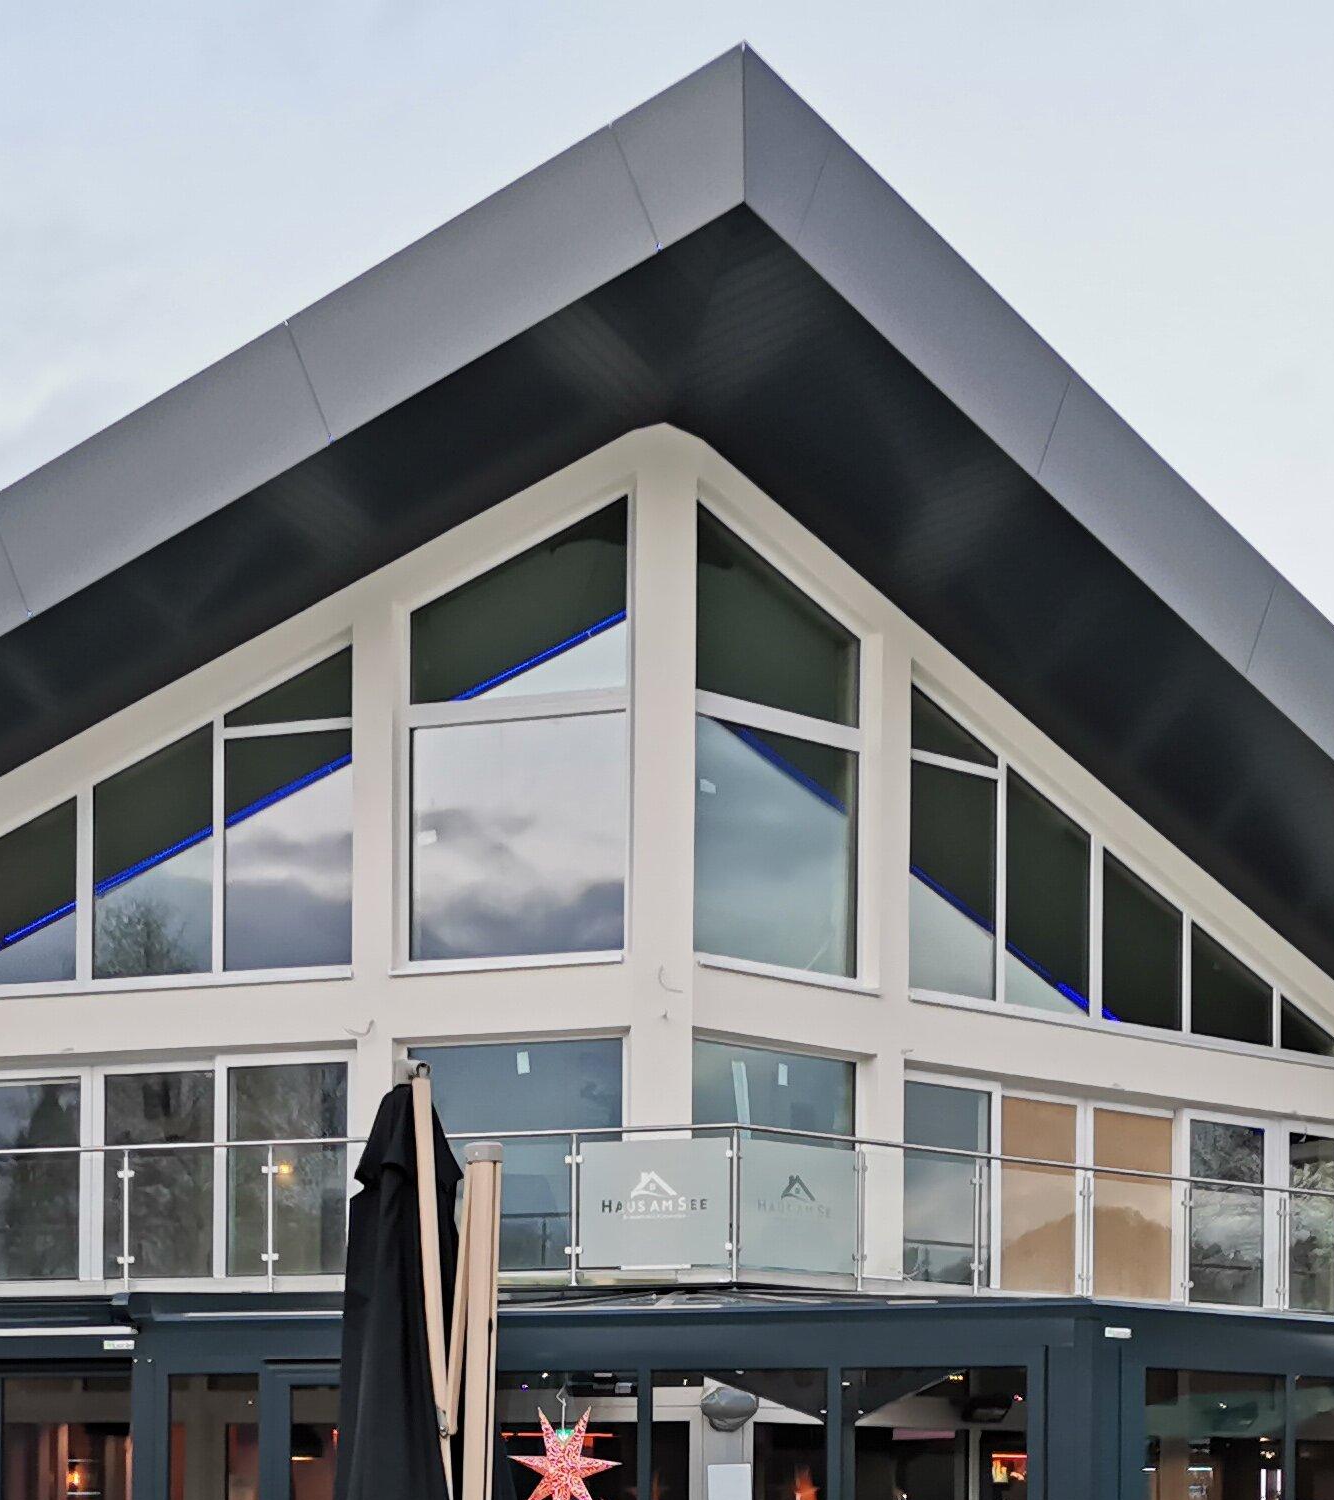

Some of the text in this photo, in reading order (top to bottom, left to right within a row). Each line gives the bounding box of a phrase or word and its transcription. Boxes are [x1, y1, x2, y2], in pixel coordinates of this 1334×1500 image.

[602, 1196, 708, 1213] HAUS AM SEE
